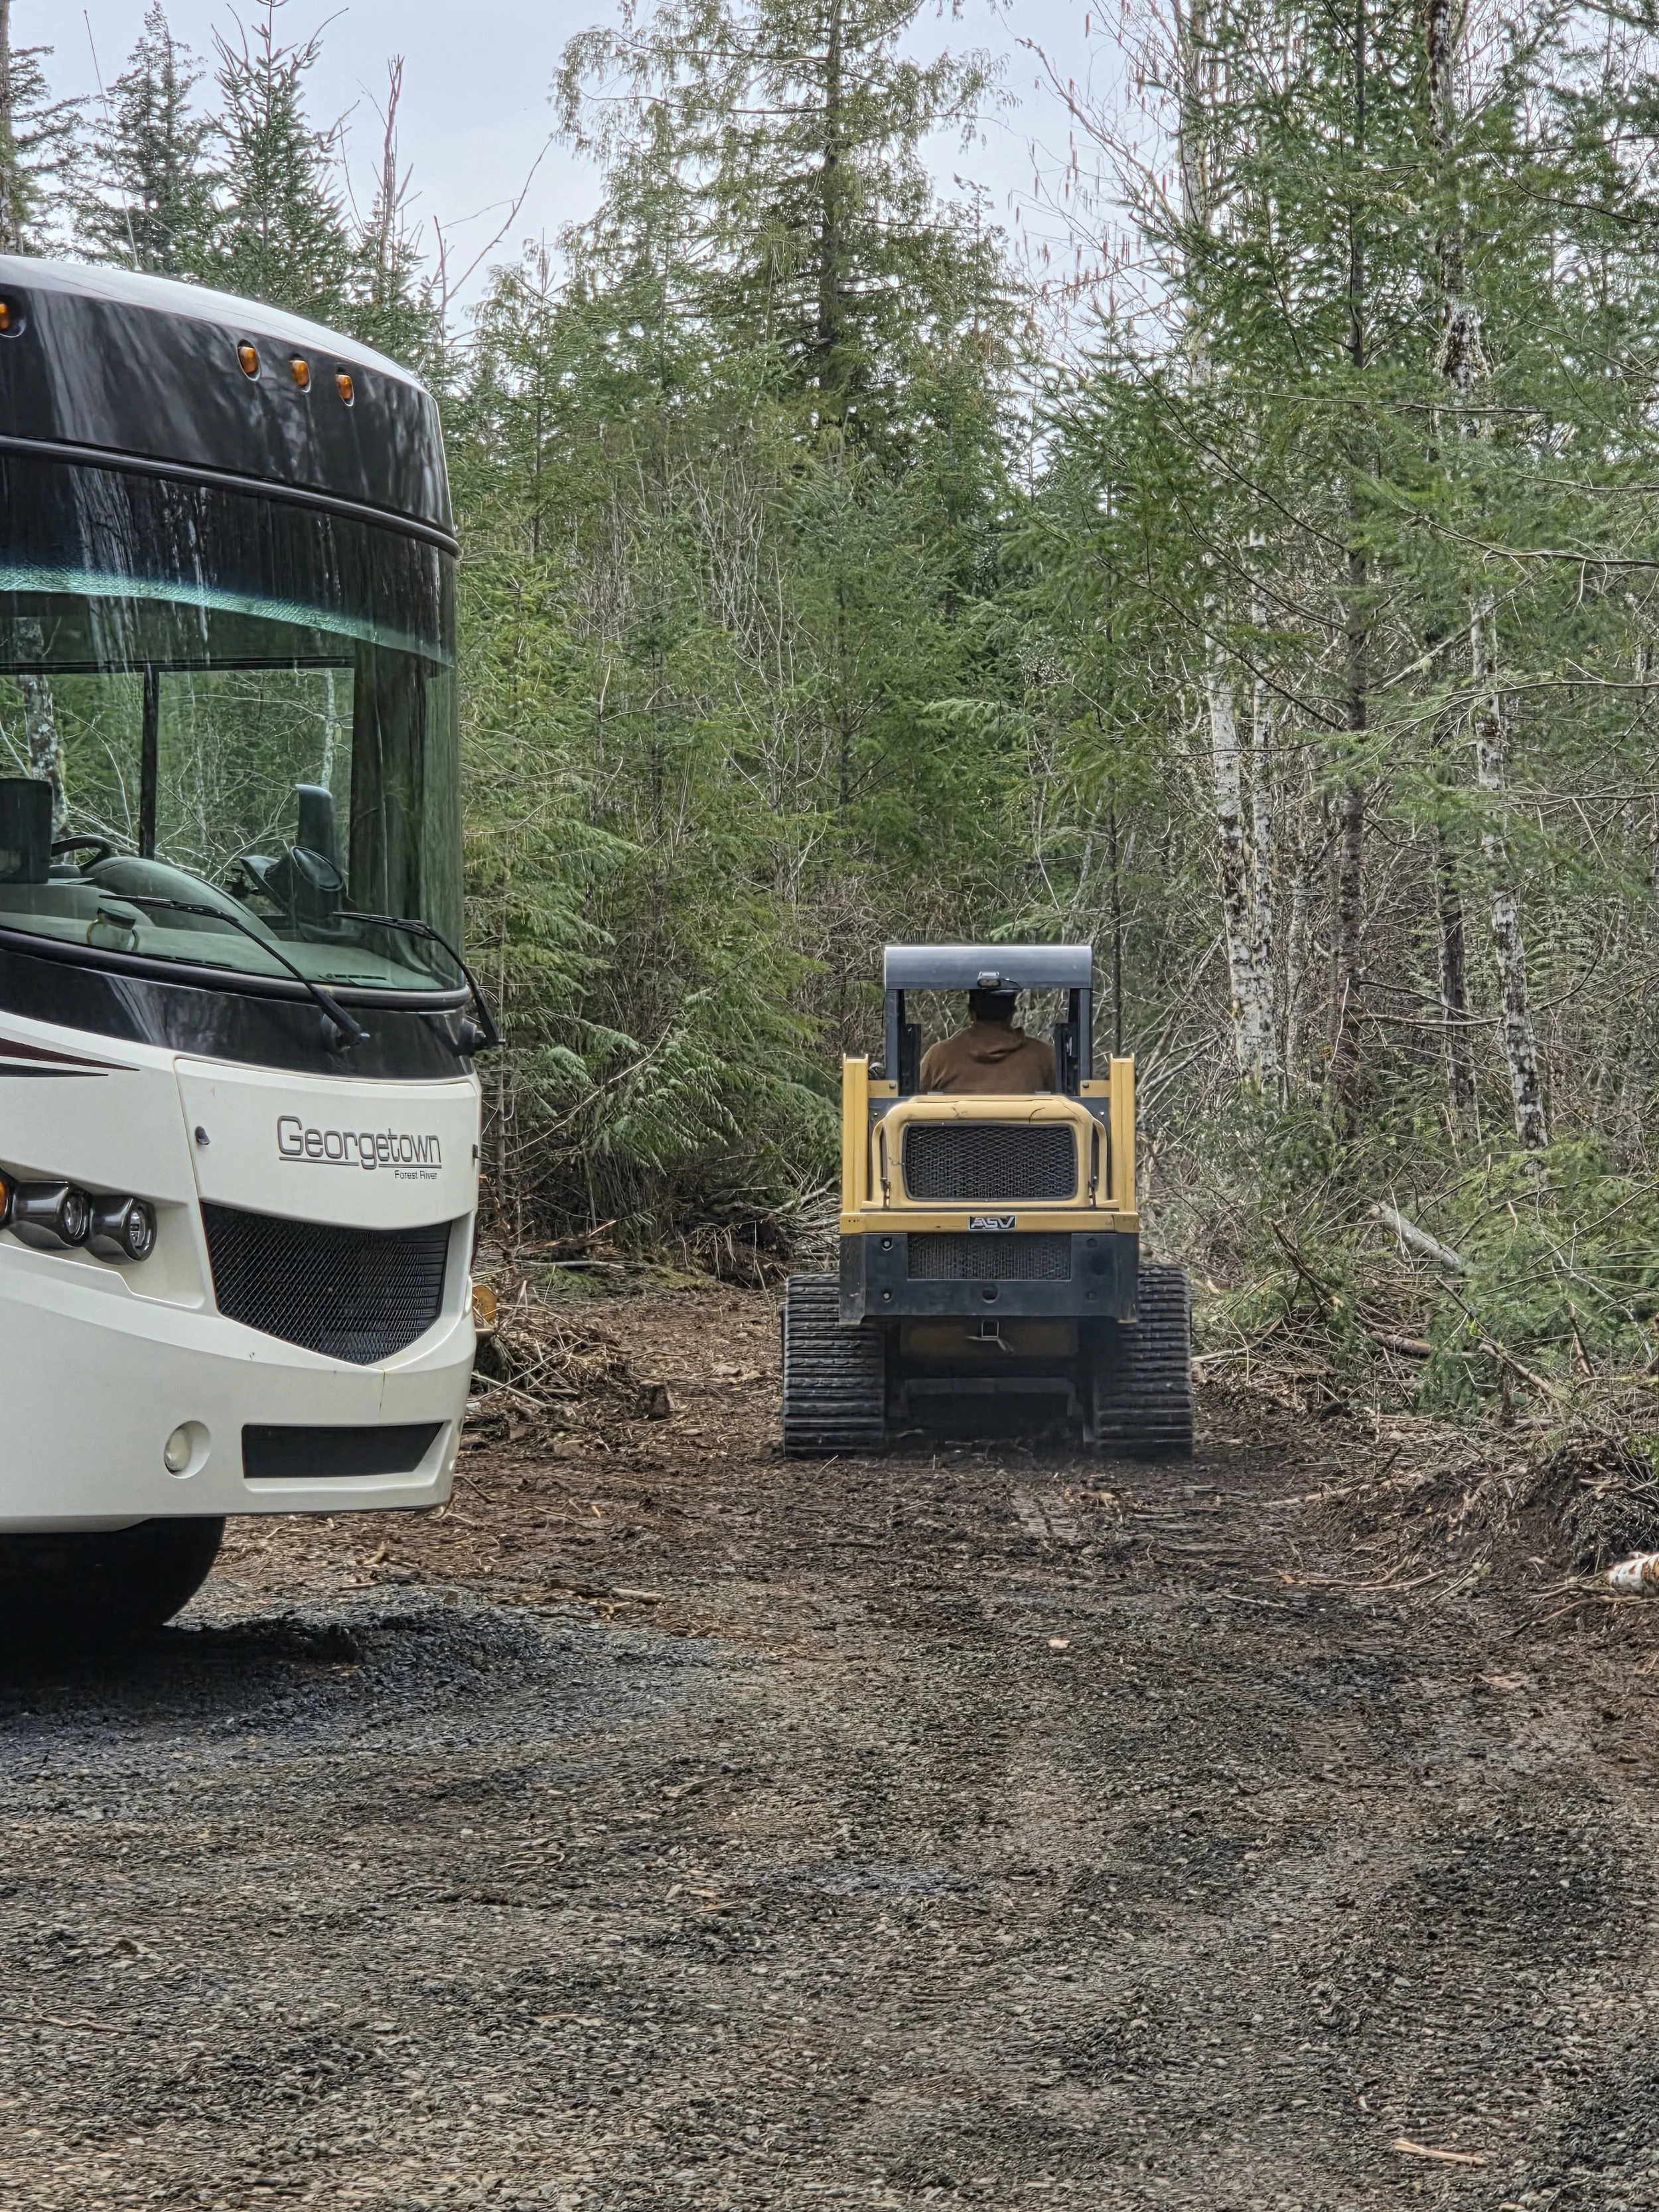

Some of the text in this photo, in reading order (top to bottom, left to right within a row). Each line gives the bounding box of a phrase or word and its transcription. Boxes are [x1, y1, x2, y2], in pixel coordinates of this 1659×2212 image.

[277, 1116, 441, 1169] Georgetown
[394, 1170, 437, 1179] Forest River
[971, 1216, 1015, 1228] ASV
